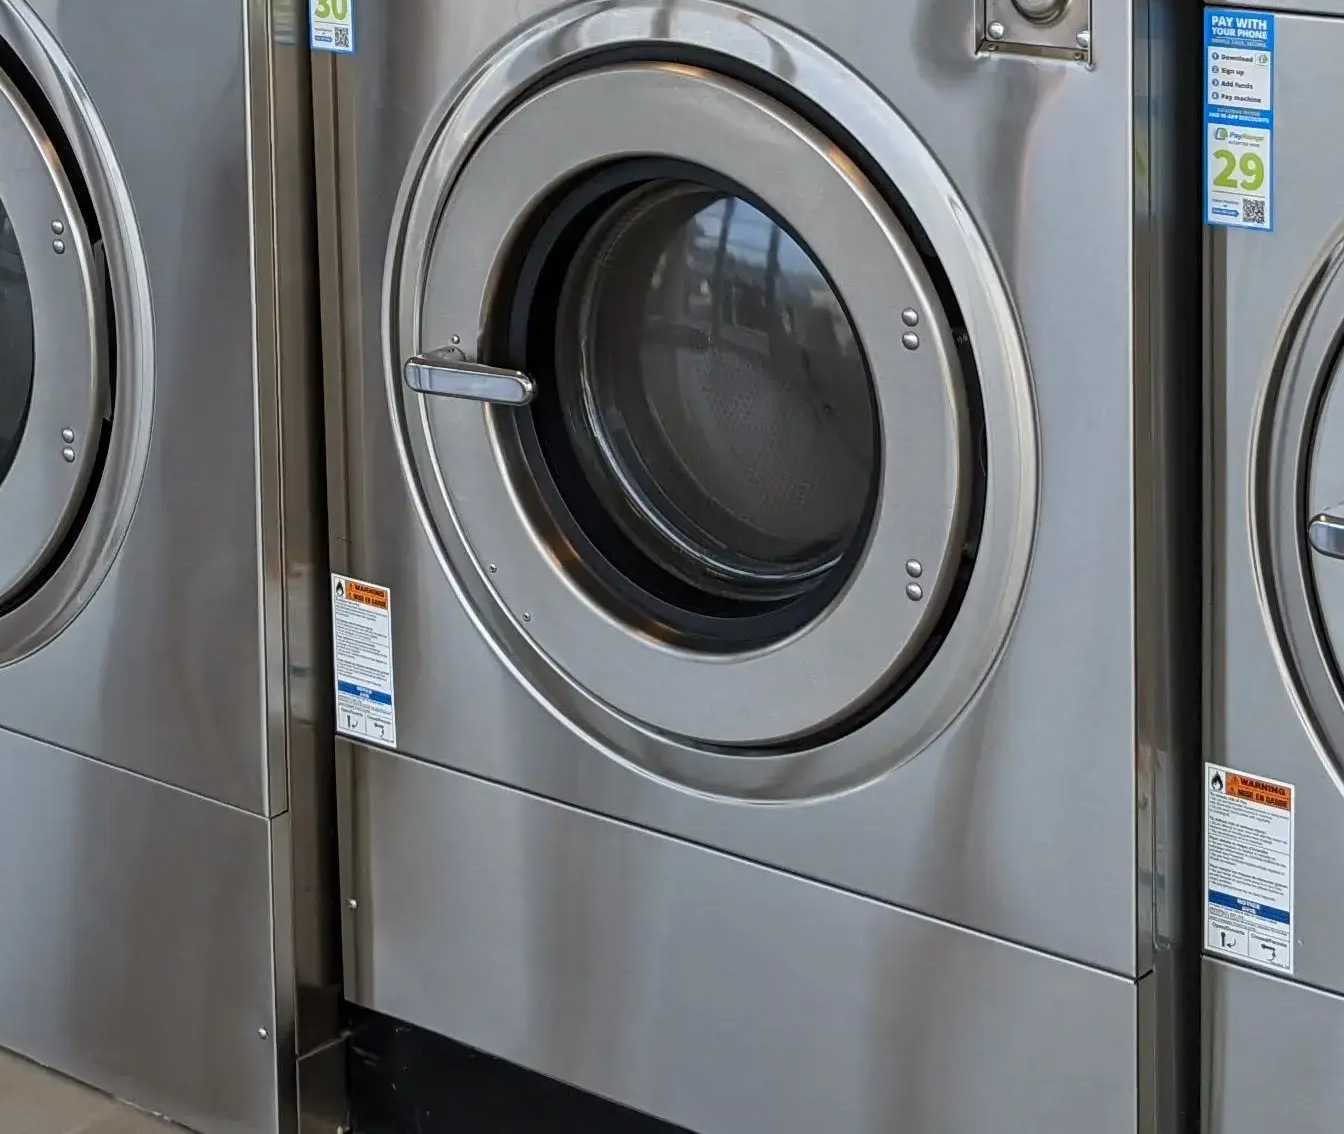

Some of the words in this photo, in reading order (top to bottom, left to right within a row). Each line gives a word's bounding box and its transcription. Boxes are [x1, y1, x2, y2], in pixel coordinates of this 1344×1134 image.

[1211, 15, 1233, 26] PAY
[1235, 17, 1268, 31] WITH
[1211, 27, 1236, 37] YOUR
[1237, 28, 1268, 40] PHONE
[1221, 53, 1254, 63] Download
[1221, 67, 1235, 76] Sign
[1236, 69, 1245, 77] up
[1221, 80, 1233, 88] Add
[1234, 81, 1254, 90] funds
[1221, 93, 1233, 102] Pay
[1233, 94, 1262, 104] machine
[1212, 148, 1265, 191] 29
[1239, 777, 1286, 796] WARNING
